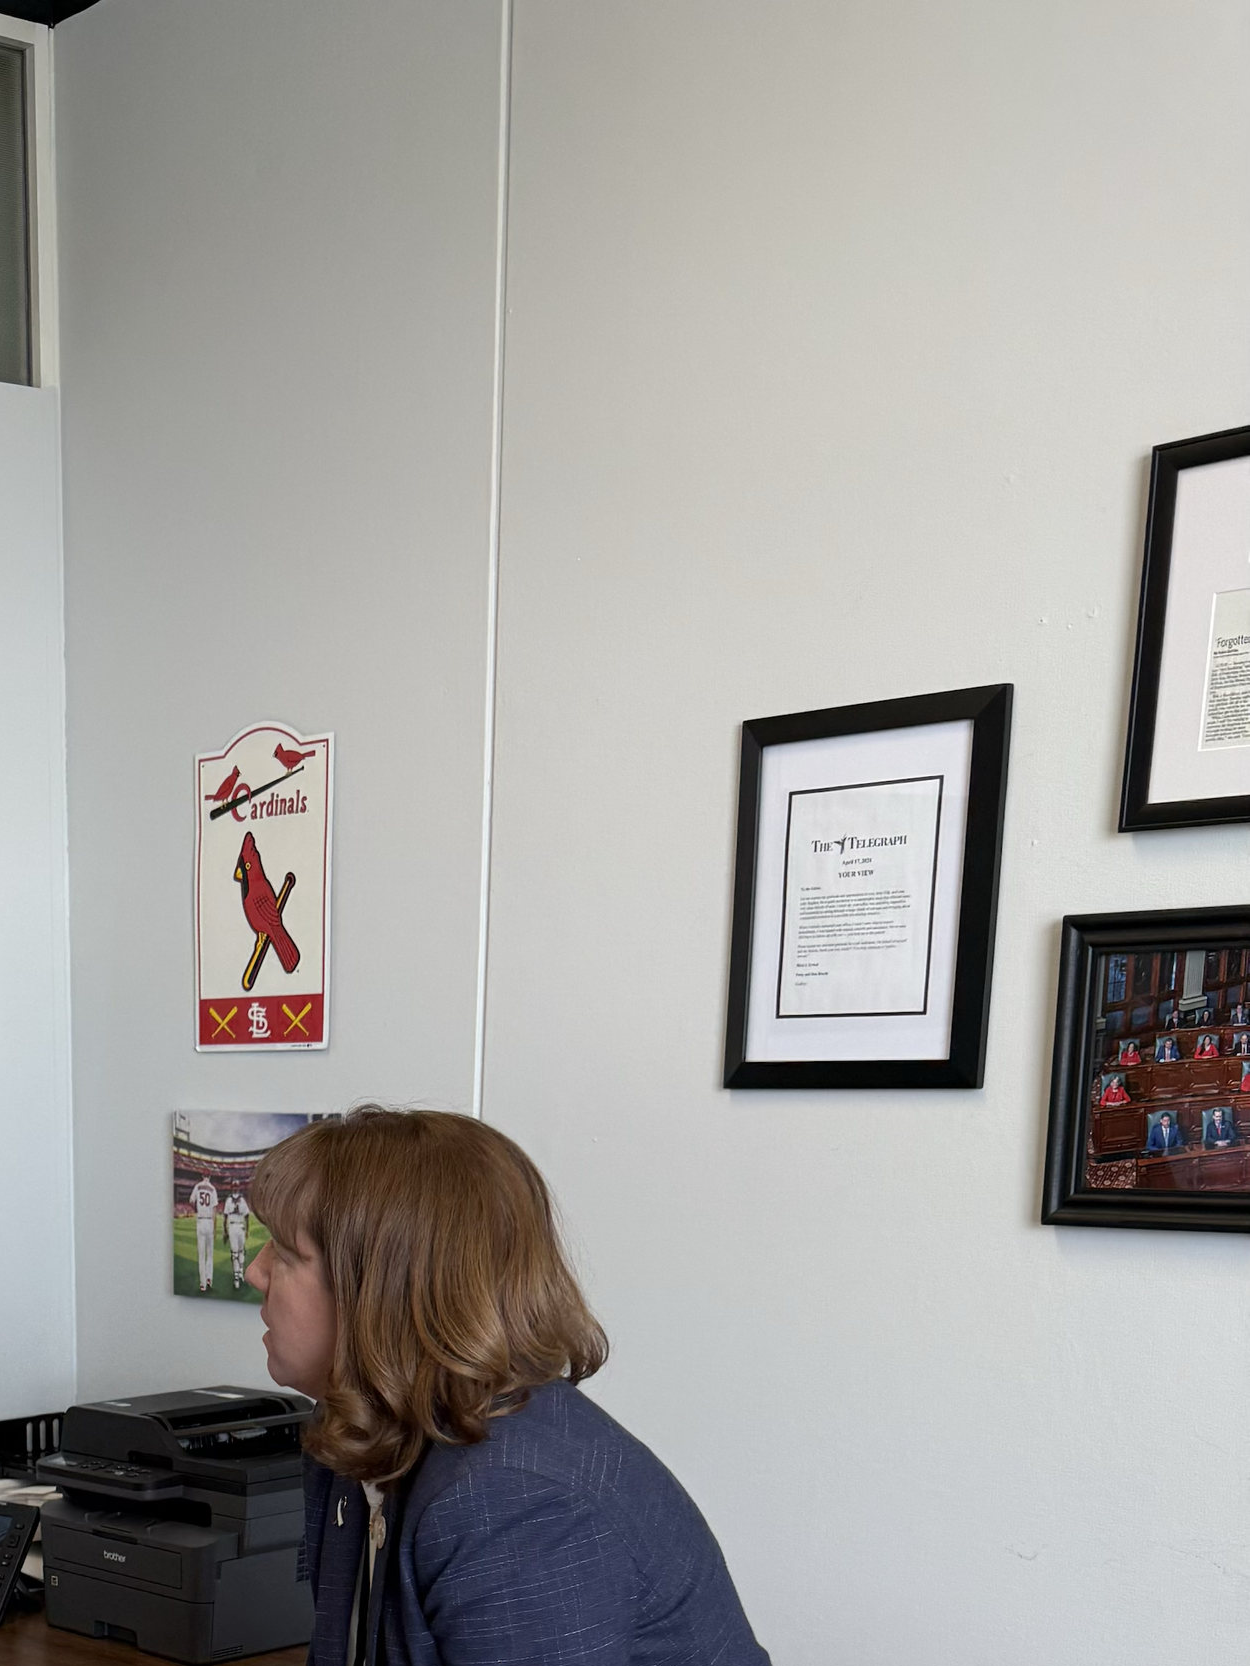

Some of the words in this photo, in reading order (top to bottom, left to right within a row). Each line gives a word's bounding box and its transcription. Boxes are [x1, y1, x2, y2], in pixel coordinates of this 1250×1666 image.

[231, 783, 308, 822] Cardinals
[848, 834, 908, 851] TELEGRAPH
[838, 870, 856, 879] YOUR
[857, 868, 875, 878] VIEW
[199, 1193, 211, 1207] 50
[103, 1549, 127, 1564] brother
